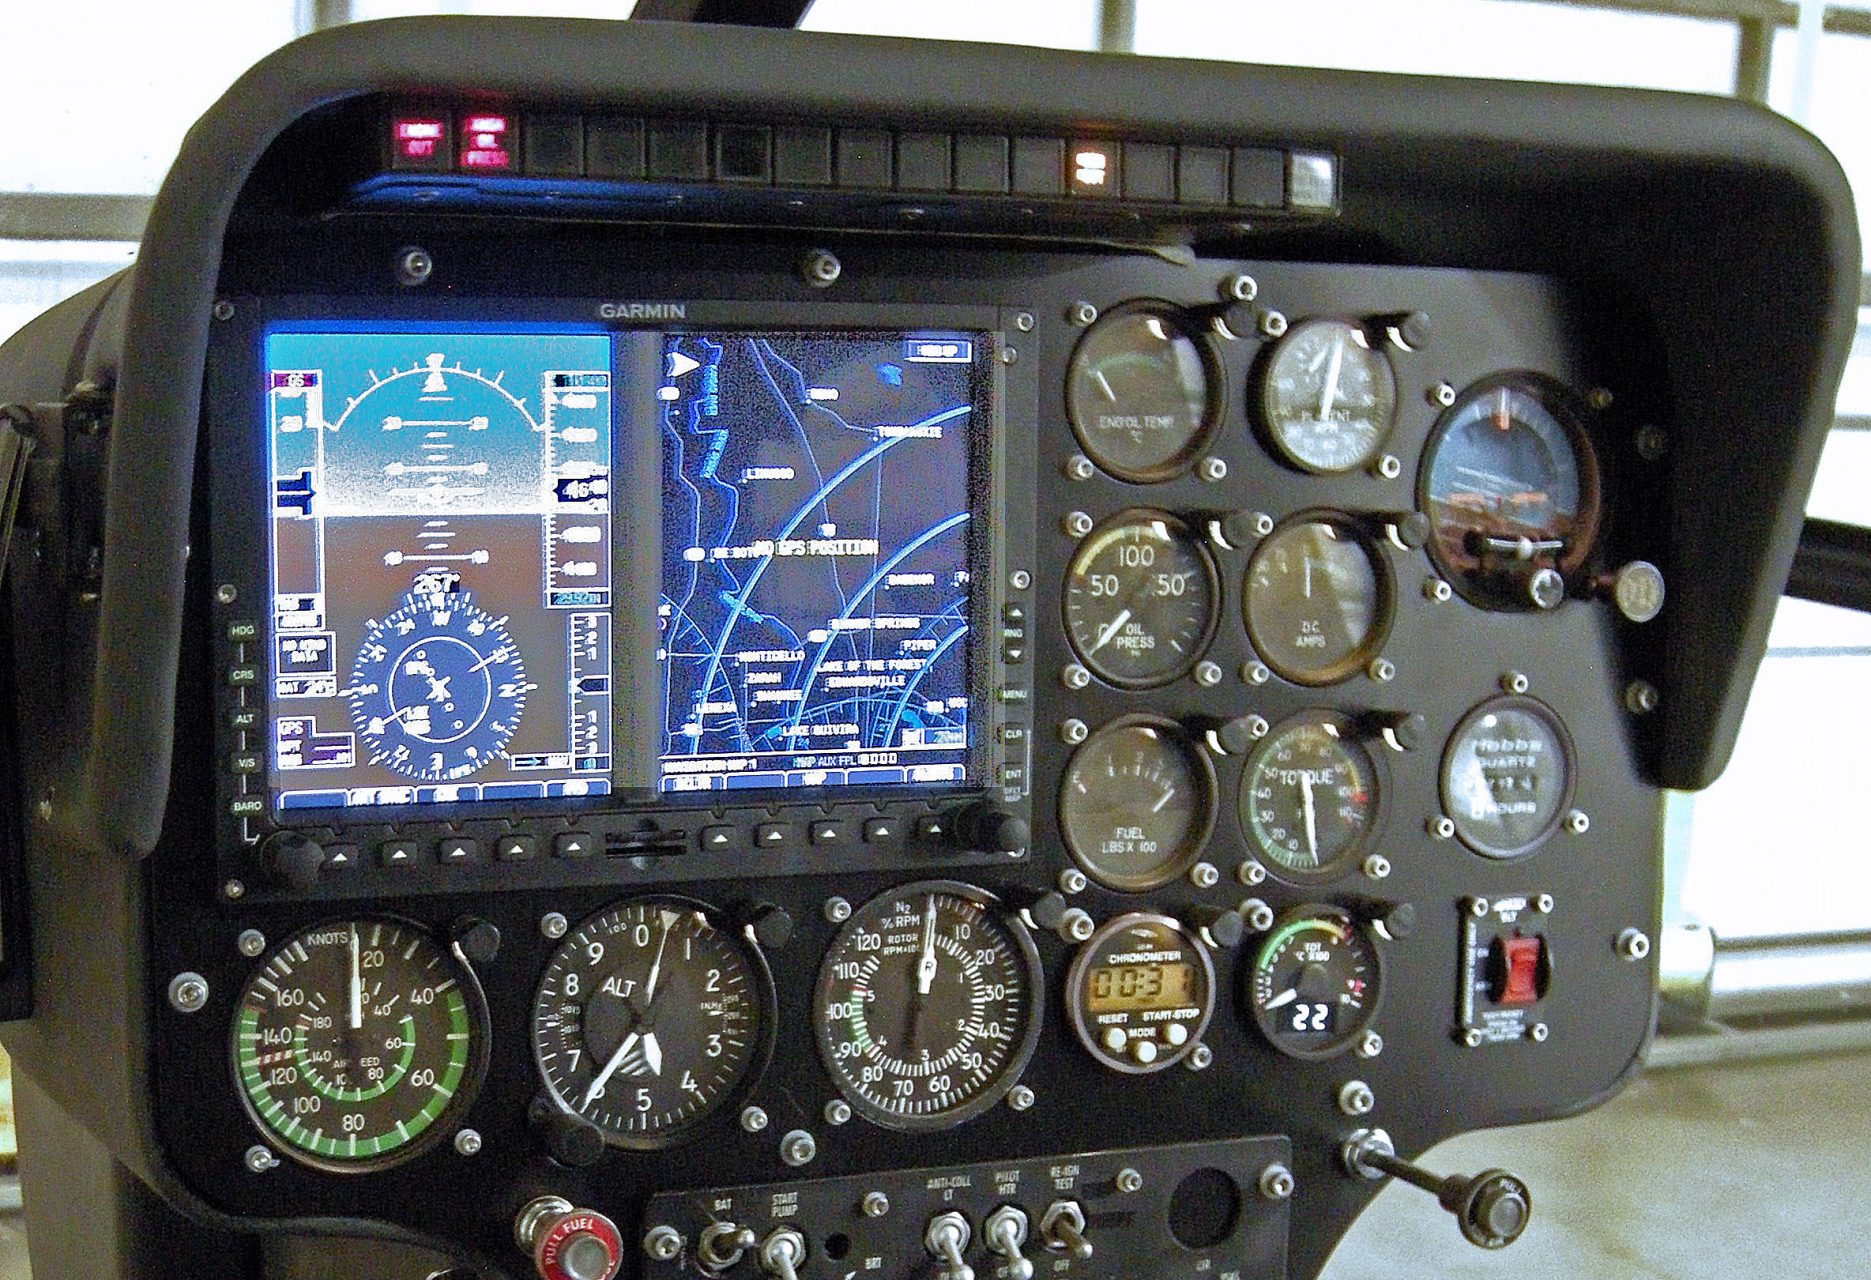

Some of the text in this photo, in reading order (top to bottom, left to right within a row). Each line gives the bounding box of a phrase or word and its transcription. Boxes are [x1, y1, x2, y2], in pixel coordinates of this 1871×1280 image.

[599, 303, 685, 320] GARMIN
[776, 540, 807, 555] GPS
[811, 539, 879, 555] POSITION
[1120, 547, 1155, 567] 100
[1089, 575, 1120, 597] 50
[1157, 574, 1186, 596] 50
[232, 625, 255, 636] HDG
[1126, 625, 1145, 636] OIL
[1116, 637, 1155, 649] PRESS
[1296, 635, 1326, 648] AMPS
[232, 670, 255, 679] CRS
[236, 714, 255, 724] ALT
[1005, 729, 1023, 739] CLR
[238, 758, 256, 768] V/S
[1005, 768, 1022, 779] ENT
[234, 801, 262, 811] BARO
[1116, 827, 1145, 839] FUEL
[1102, 842, 1157, 853] LBS X 100
[608, 922, 628, 934] 100
[896, 916, 920, 928] RPM
[307, 932, 348, 946] KNOTS
[635, 924, 650, 947] 0
[888, 934, 919, 943] ROTOR
[956, 924, 971, 940] 10
[685, 938, 691, 960] 1
[857, 934, 881, 951] 120
[1304, 942, 1321, 951] TOT
[363, 951, 384, 967] 20
[588, 942, 605, 966] 9
[976, 949, 995, 965] 20
[1108, 951, 1181, 964] CHRONOMETER
[839, 963, 860, 979] 110
[925, 962, 932, 971] R
[565, 973, 580, 996] 8
[602, 976, 637, 997] ALT
[705, 969, 721, 992] 2
[277, 990, 304, 1006] 160
[411, 988, 433, 1005] 40
[867, 990, 875, 1002] 5
[985, 984, 1005, 1000] 30
[374, 1005, 391, 1016] 40
[830, 1003, 852, 1019] 100
[1293, 1004, 1328, 1031] 22
[313, 1017, 332, 1028] 180
[958, 1020, 965, 1030] 2
[1098, 1014, 1130, 1024] RESET
[264, 1028, 292, 1044] 140
[978, 1023, 1000, 1038] 40
[1128, 1028, 1156, 1038] MODE
[385, 1038, 403, 1049] 60
[706, 1034, 722, 1057] 3
[879, 1035, 887, 1046] 4
[312, 1050, 332, 1062] 140
[841, 1041, 861, 1057] 90
[921, 1049, 930, 1061] 3
[567, 1049, 581, 1073] 7
[962, 1053, 983, 1070] 50
[271, 1067, 297, 1084] 120
[368, 1068, 384, 1080] 80
[412, 1069, 434, 1086] 60
[680, 1070, 698, 1092] 4
[862, 1065, 883, 1082] 80
[894, 1080, 914, 1096] 70
[929, 1076, 951, 1093] 60
[294, 1096, 321, 1114] 100
[637, 1088, 652, 1112] 5
[343, 1114, 365, 1131] 80
[927, 1176, 972, 1188] ANTI-COLL
[1054, 1177, 1076, 1191] TEST
[772, 1191, 798, 1204] START
[998, 1184, 1017, 1196] HTR
[714, 1199, 732, 1211] BAT
[772, 1204, 798, 1218] PUMP
[545, 1235, 563, 1265] PULL
[563, 1218, 594, 1233] FUEL
